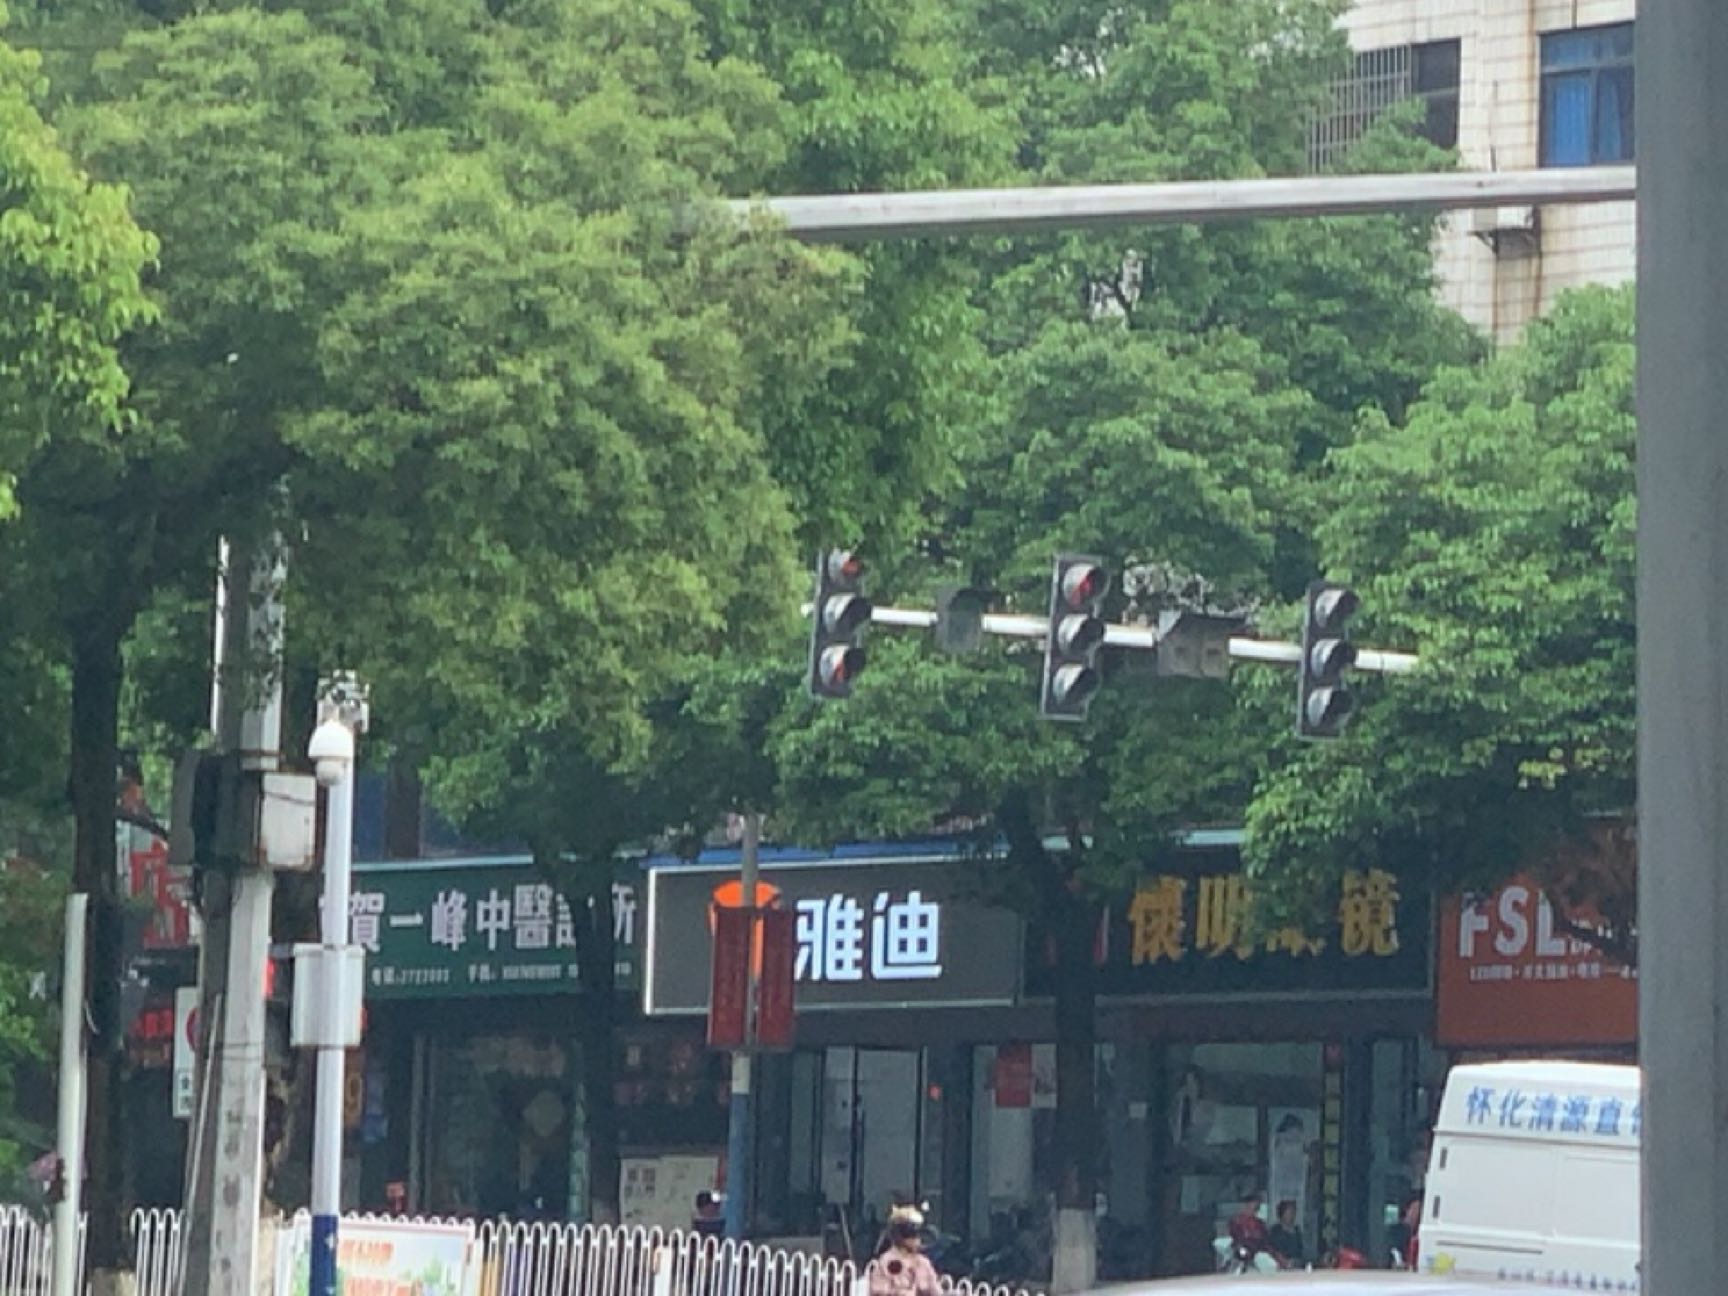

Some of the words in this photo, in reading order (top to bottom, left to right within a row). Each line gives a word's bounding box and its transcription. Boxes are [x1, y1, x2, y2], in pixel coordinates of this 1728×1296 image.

[794, 890, 943, 981] 雅迪
[1459, 885, 1566, 958] FSL
[1466, 1086, 1641, 1137] 怀化清源直
